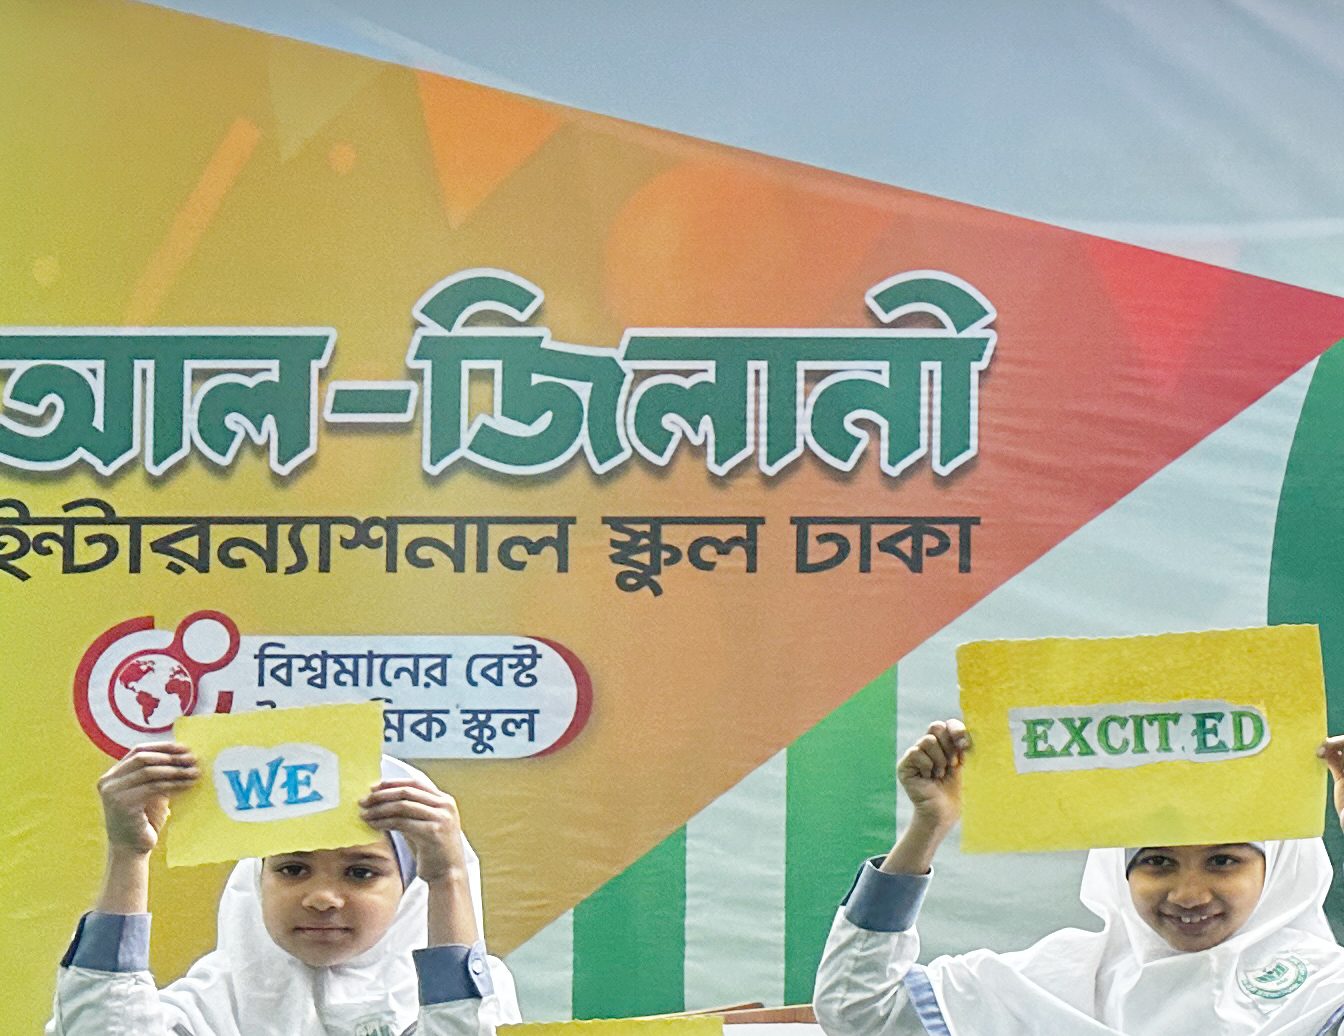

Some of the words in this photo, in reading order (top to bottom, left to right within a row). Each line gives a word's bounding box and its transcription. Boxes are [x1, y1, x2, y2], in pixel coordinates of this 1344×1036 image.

[607, 515, 765, 597] স্কুল
[790, 515, 981, 575] ঢাকা
[254, 642, 453, 690] বিশ্বমানের
[464, 644, 543, 688] বেস্ট
[459, 708, 541, 755] স্কুল
[1021, 709, 1266, 760] EXCITED
[221, 755, 324, 812] WE
